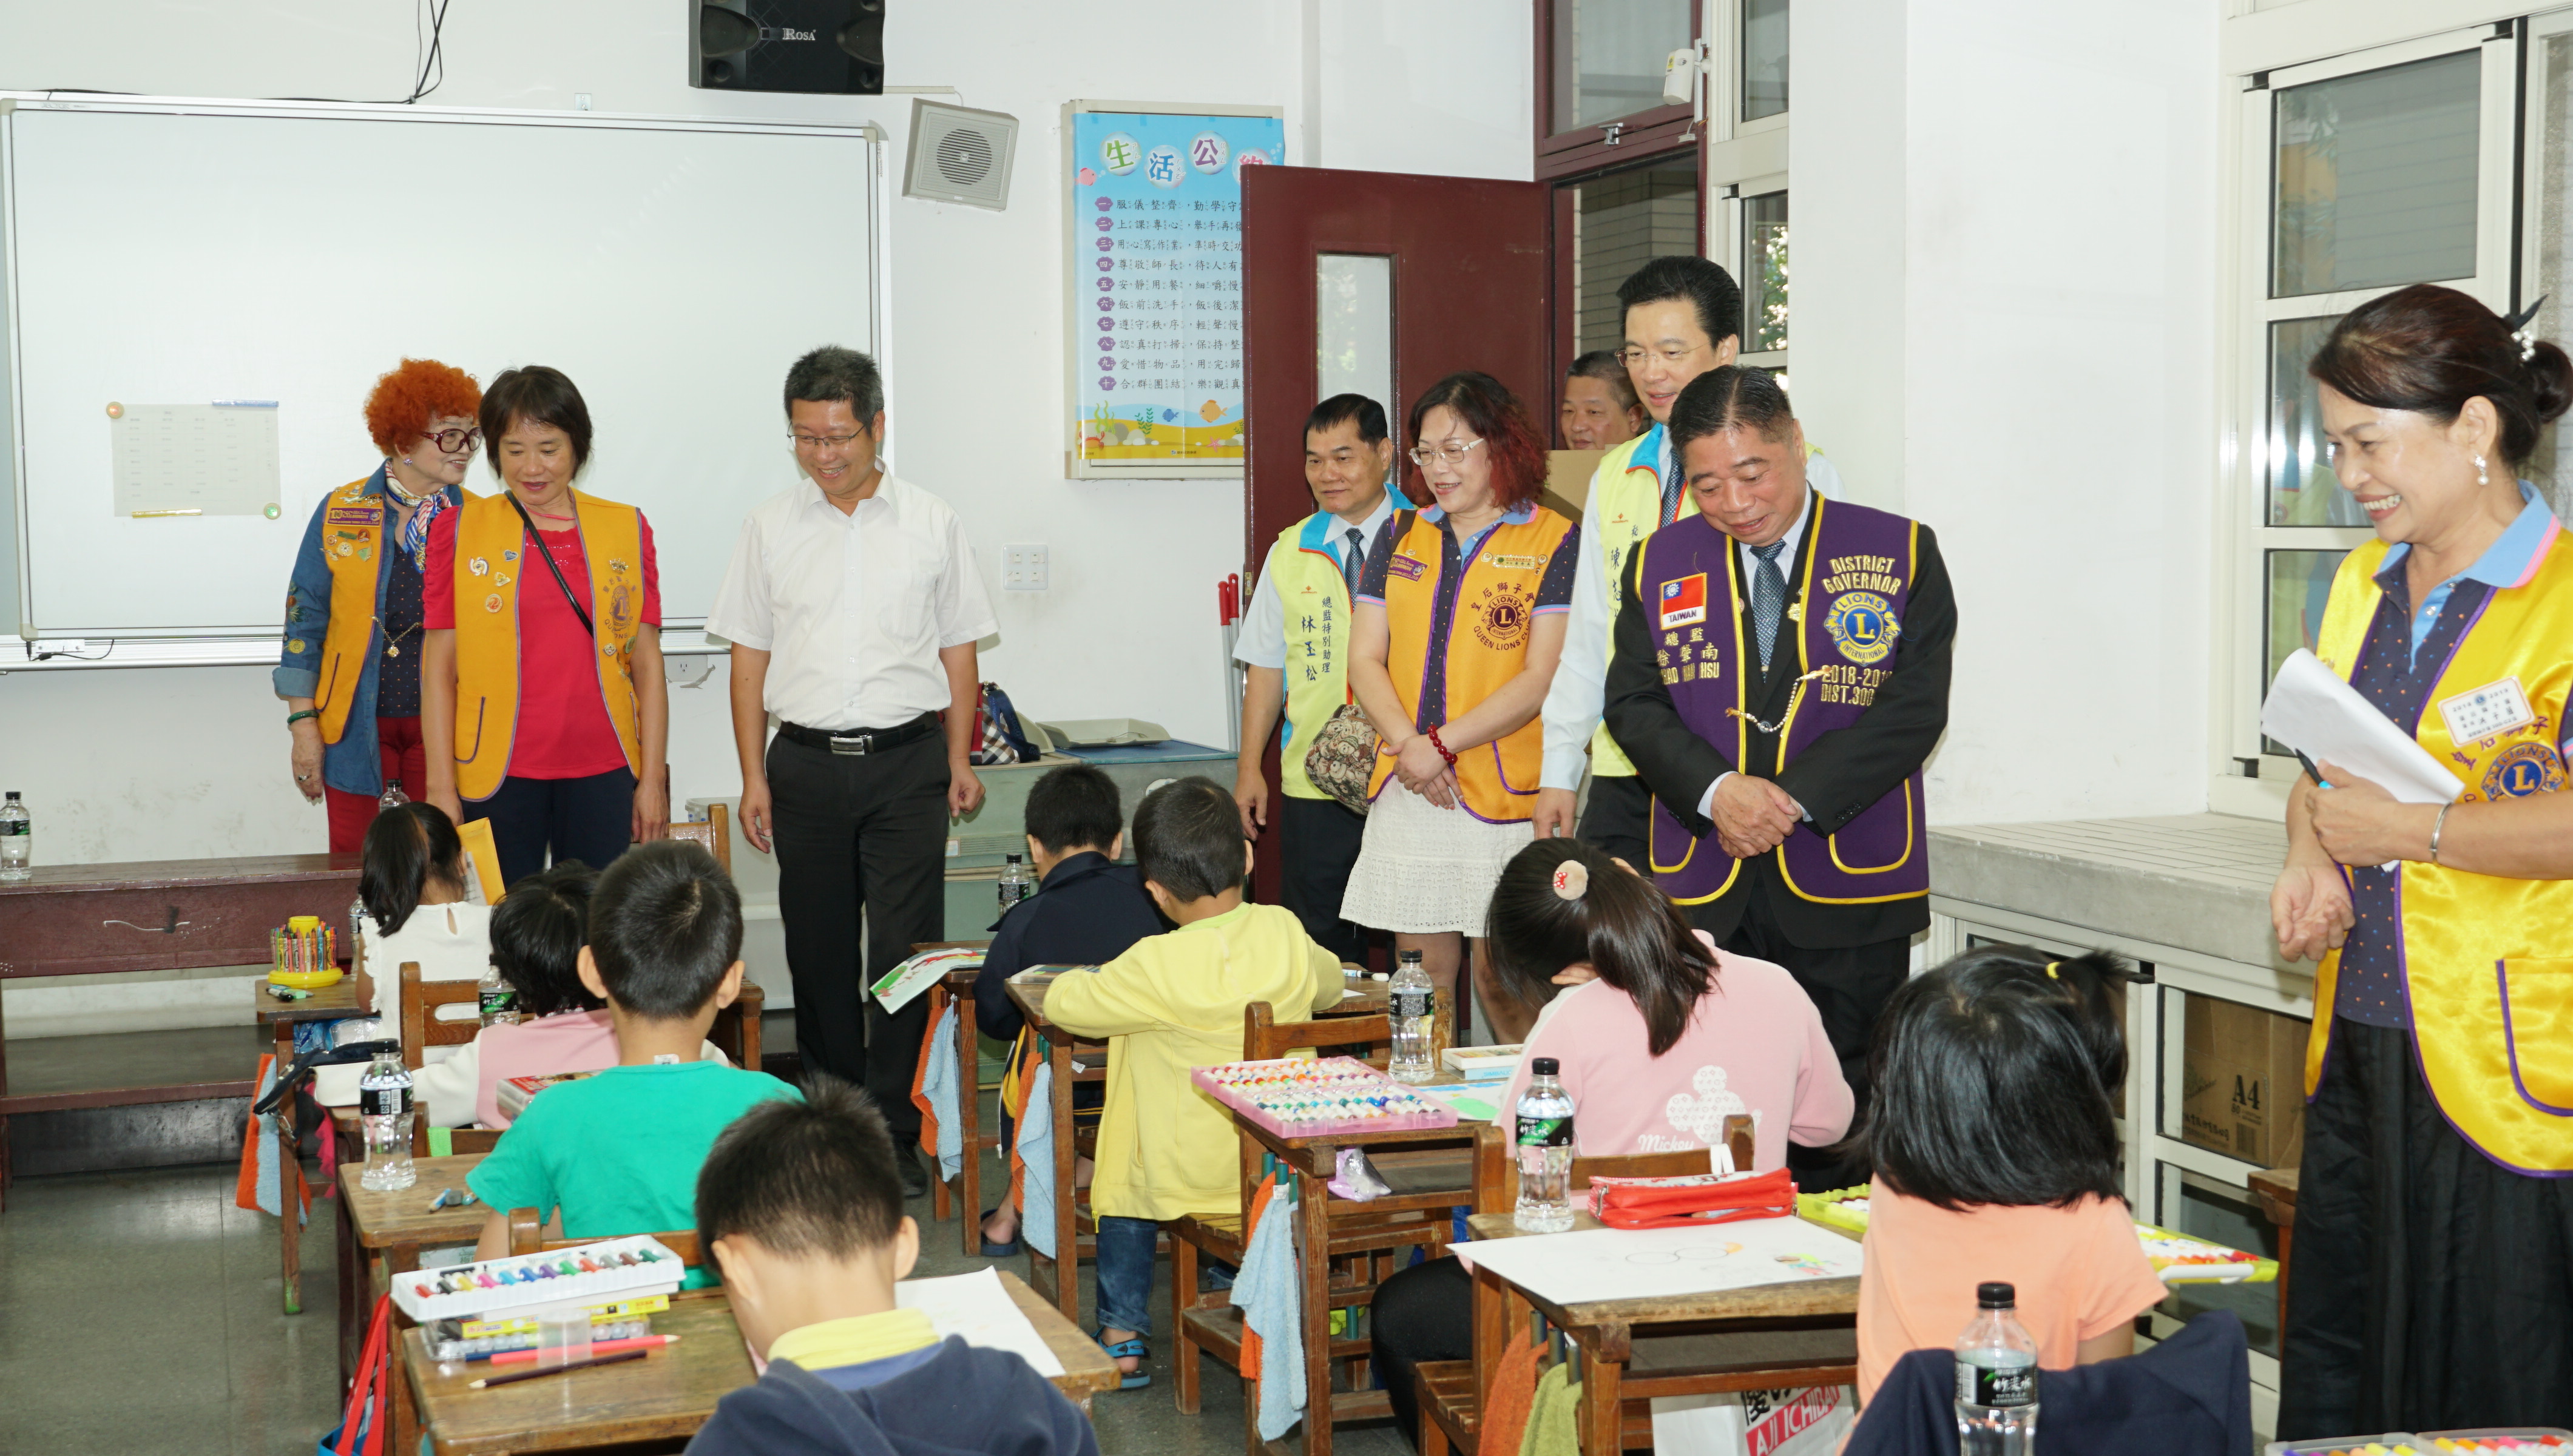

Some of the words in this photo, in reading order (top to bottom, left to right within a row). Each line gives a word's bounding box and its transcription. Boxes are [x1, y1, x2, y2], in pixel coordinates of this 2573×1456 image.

[782, 28, 816, 41] ROSA
[1829, 554, 1896, 574] DISTRICT
[1822, 572, 1902, 595] GOVERNOR
[1492, 596, 1520, 607] LIONS
[1838, 593, 1884, 607] LIONS
[1499, 608, 1512, 624] L
[1668, 609, 1697, 623] TAIWAN
[1853, 613, 1876, 639] L
[1322, 596, 1333, 673] 總監特別助理
[1473, 625, 1495, 649] QUEEN
[1496, 639, 1521, 651] LIONS
[1491, 628, 1518, 637] INTERNATIONAL
[1664, 627, 1704, 647] 總監
[1301, 615, 1317, 682] 林玉松
[1657, 642, 1719, 667] 徐肇南
[1842, 643, 1885, 661] INTERNATIONAL
[1699, 662, 1720, 679] HSU
[2500, 746, 2548, 764] LIONS
[2512, 765, 2535, 791] L
[2232, 1074, 2260, 1110] A4
[1637, 1133, 1694, 1151] Mickey
[1756, 1415, 1779, 1456] AJI
